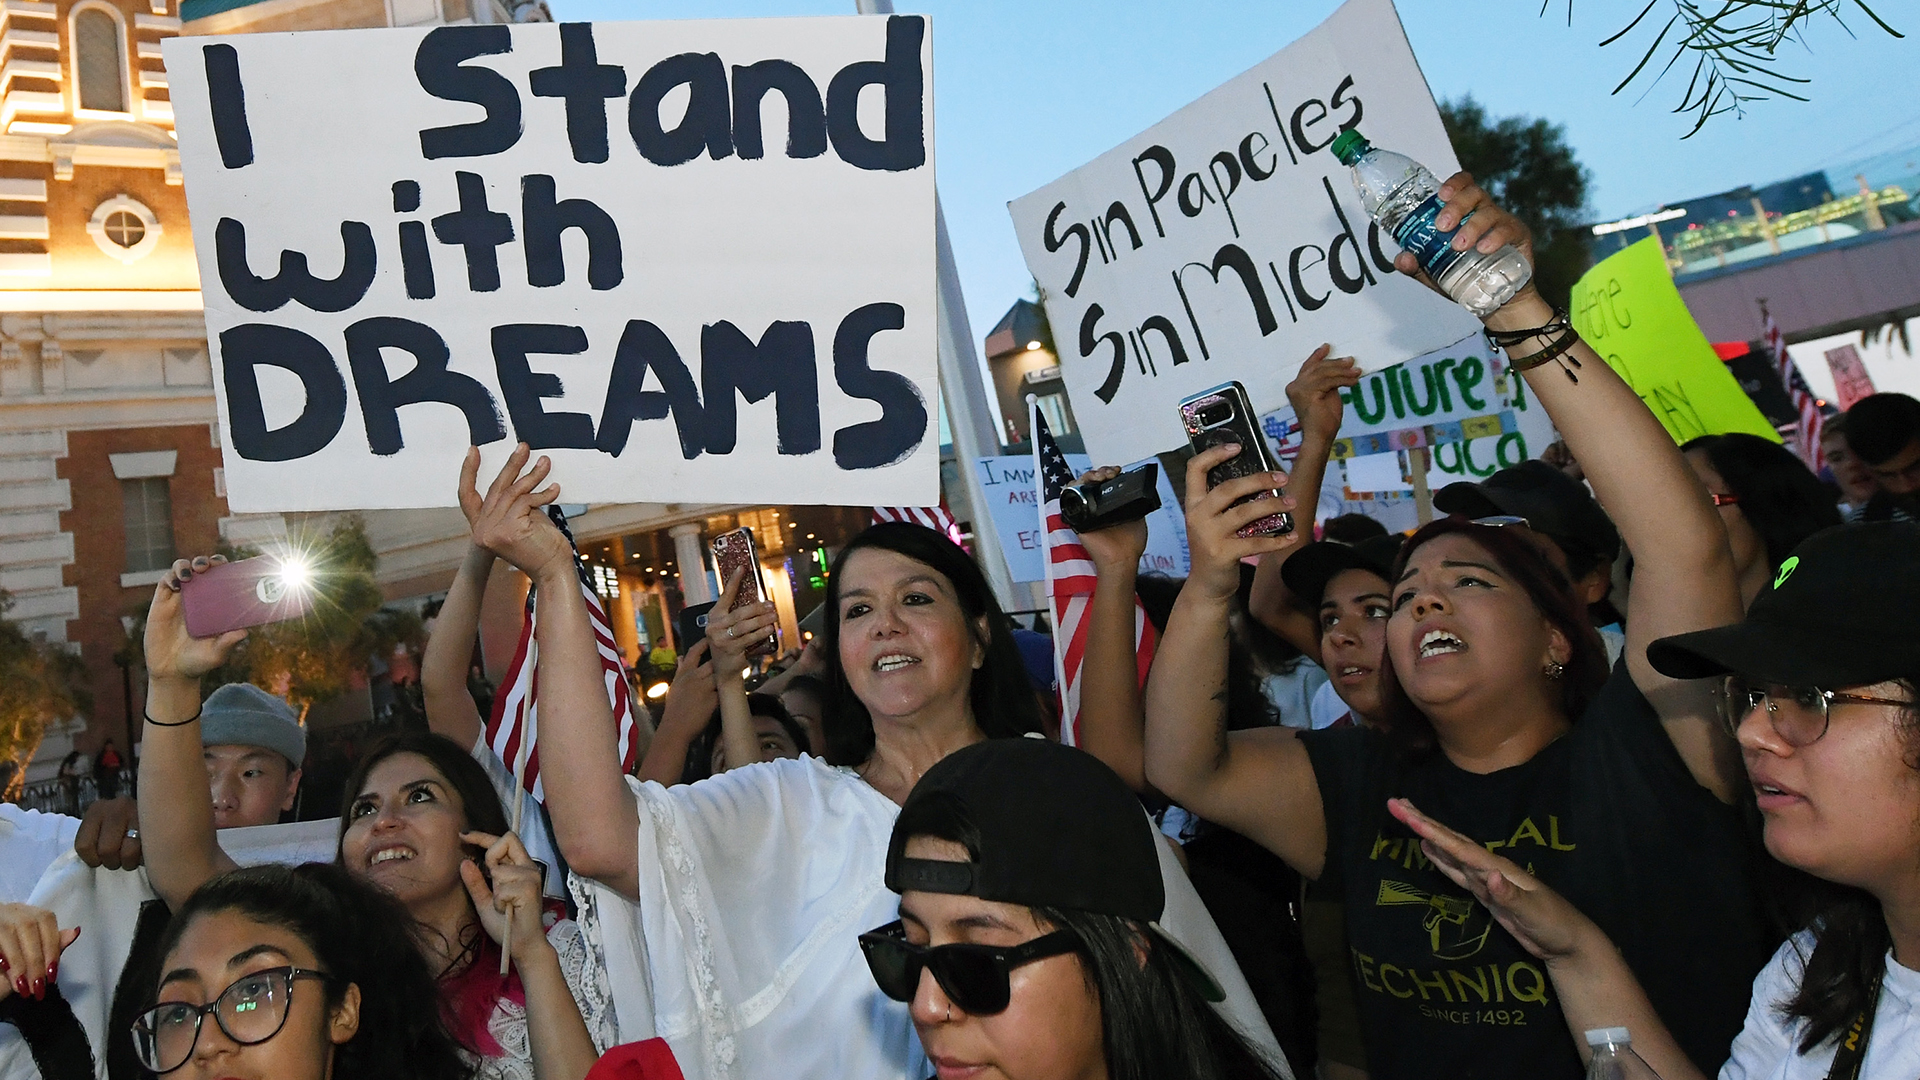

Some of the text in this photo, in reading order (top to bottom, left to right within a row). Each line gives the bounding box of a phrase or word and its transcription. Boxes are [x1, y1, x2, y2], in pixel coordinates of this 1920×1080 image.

[203, 14, 926, 172] I Stand
[215, 171, 624, 312] with
[1043, 74, 1364, 298] Sin Papeles
[218, 301, 928, 472] DREAMS
[1079, 302, 1190, 405] Sin
[1342, 356, 1487, 425] uture
[1418, 1003, 1527, 1026] SINCE 1492
